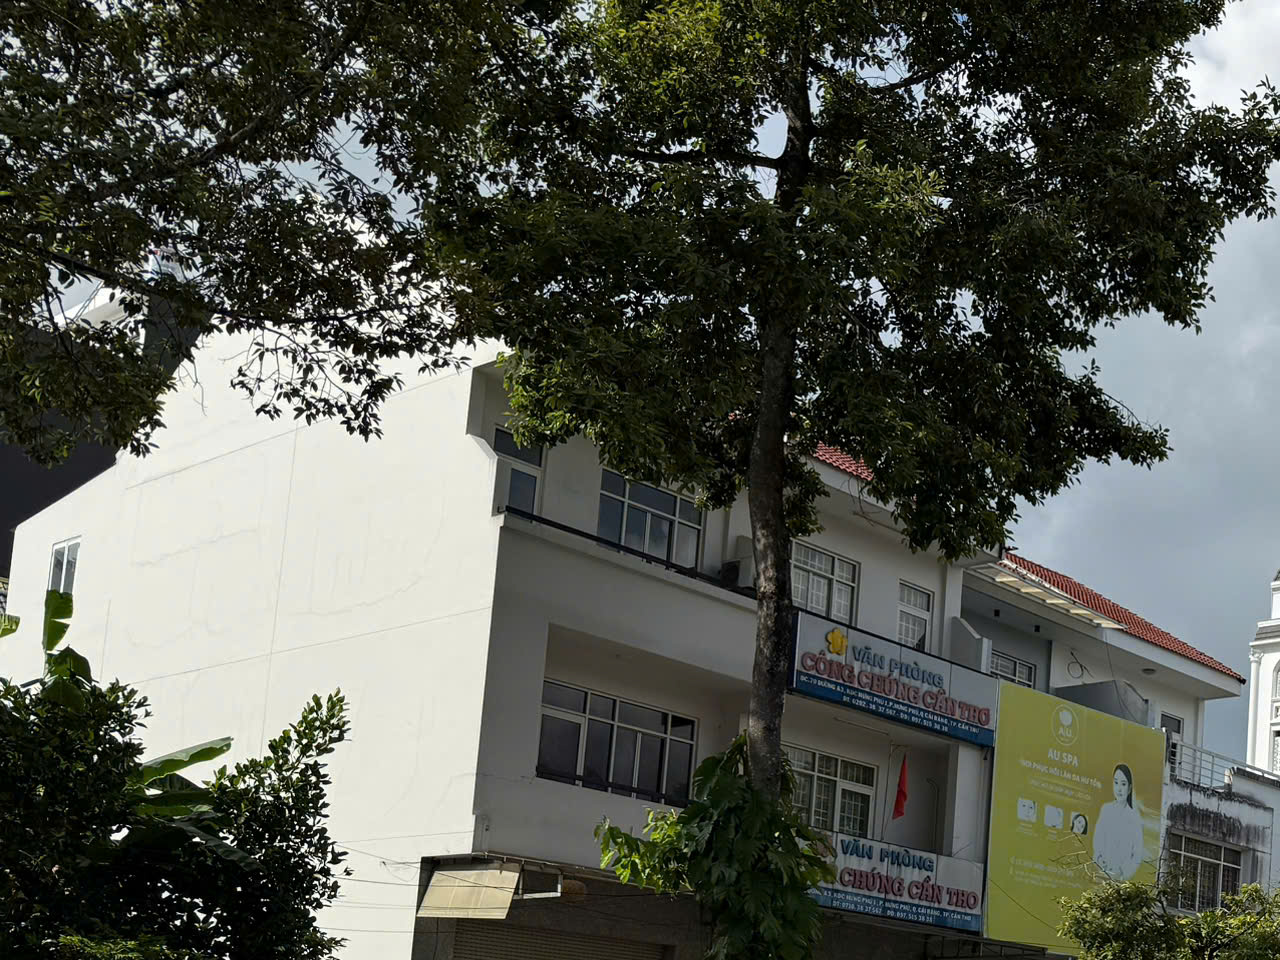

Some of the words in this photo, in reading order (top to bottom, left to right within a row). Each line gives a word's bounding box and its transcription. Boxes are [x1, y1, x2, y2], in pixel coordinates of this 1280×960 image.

[801, 650, 856, 685] CÔNG
[852, 645, 886, 671] VĂN
[890, 658, 945, 689] PHÒNG
[1062, 751, 1080, 769] SPA
[841, 838, 873, 860] VĂN
[880, 847, 935, 873] PHÒNG
